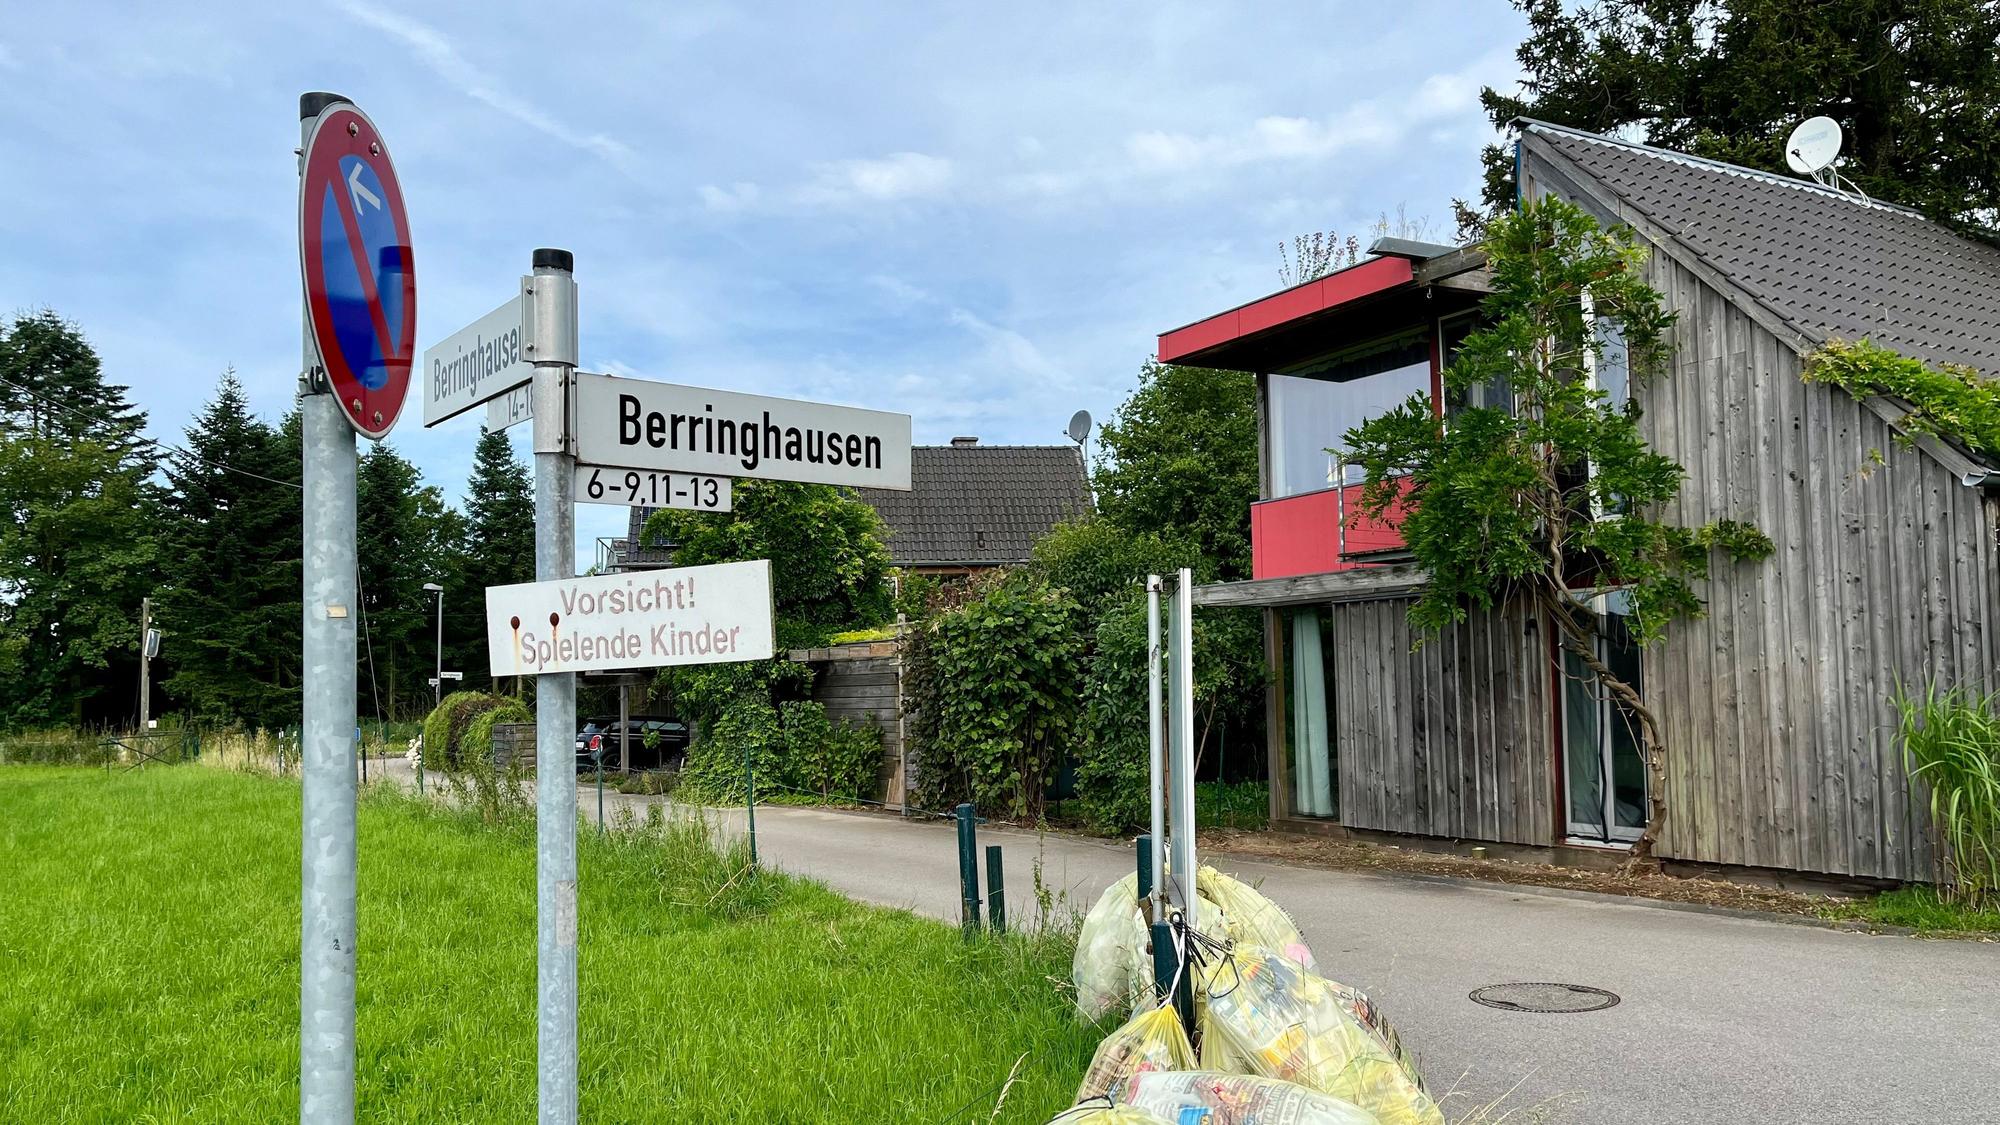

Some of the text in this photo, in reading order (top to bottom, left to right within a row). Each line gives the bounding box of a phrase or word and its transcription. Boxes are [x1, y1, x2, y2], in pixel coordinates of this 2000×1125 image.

[434, 325, 521, 403] Berringhause
[619, 393, 882, 471] Berringhausen
[587, 468, 719, 508] 6-9,11-13
[560, 576, 695, 616] Vorsicht!
[521, 621, 740, 672] Spielende Kinder
